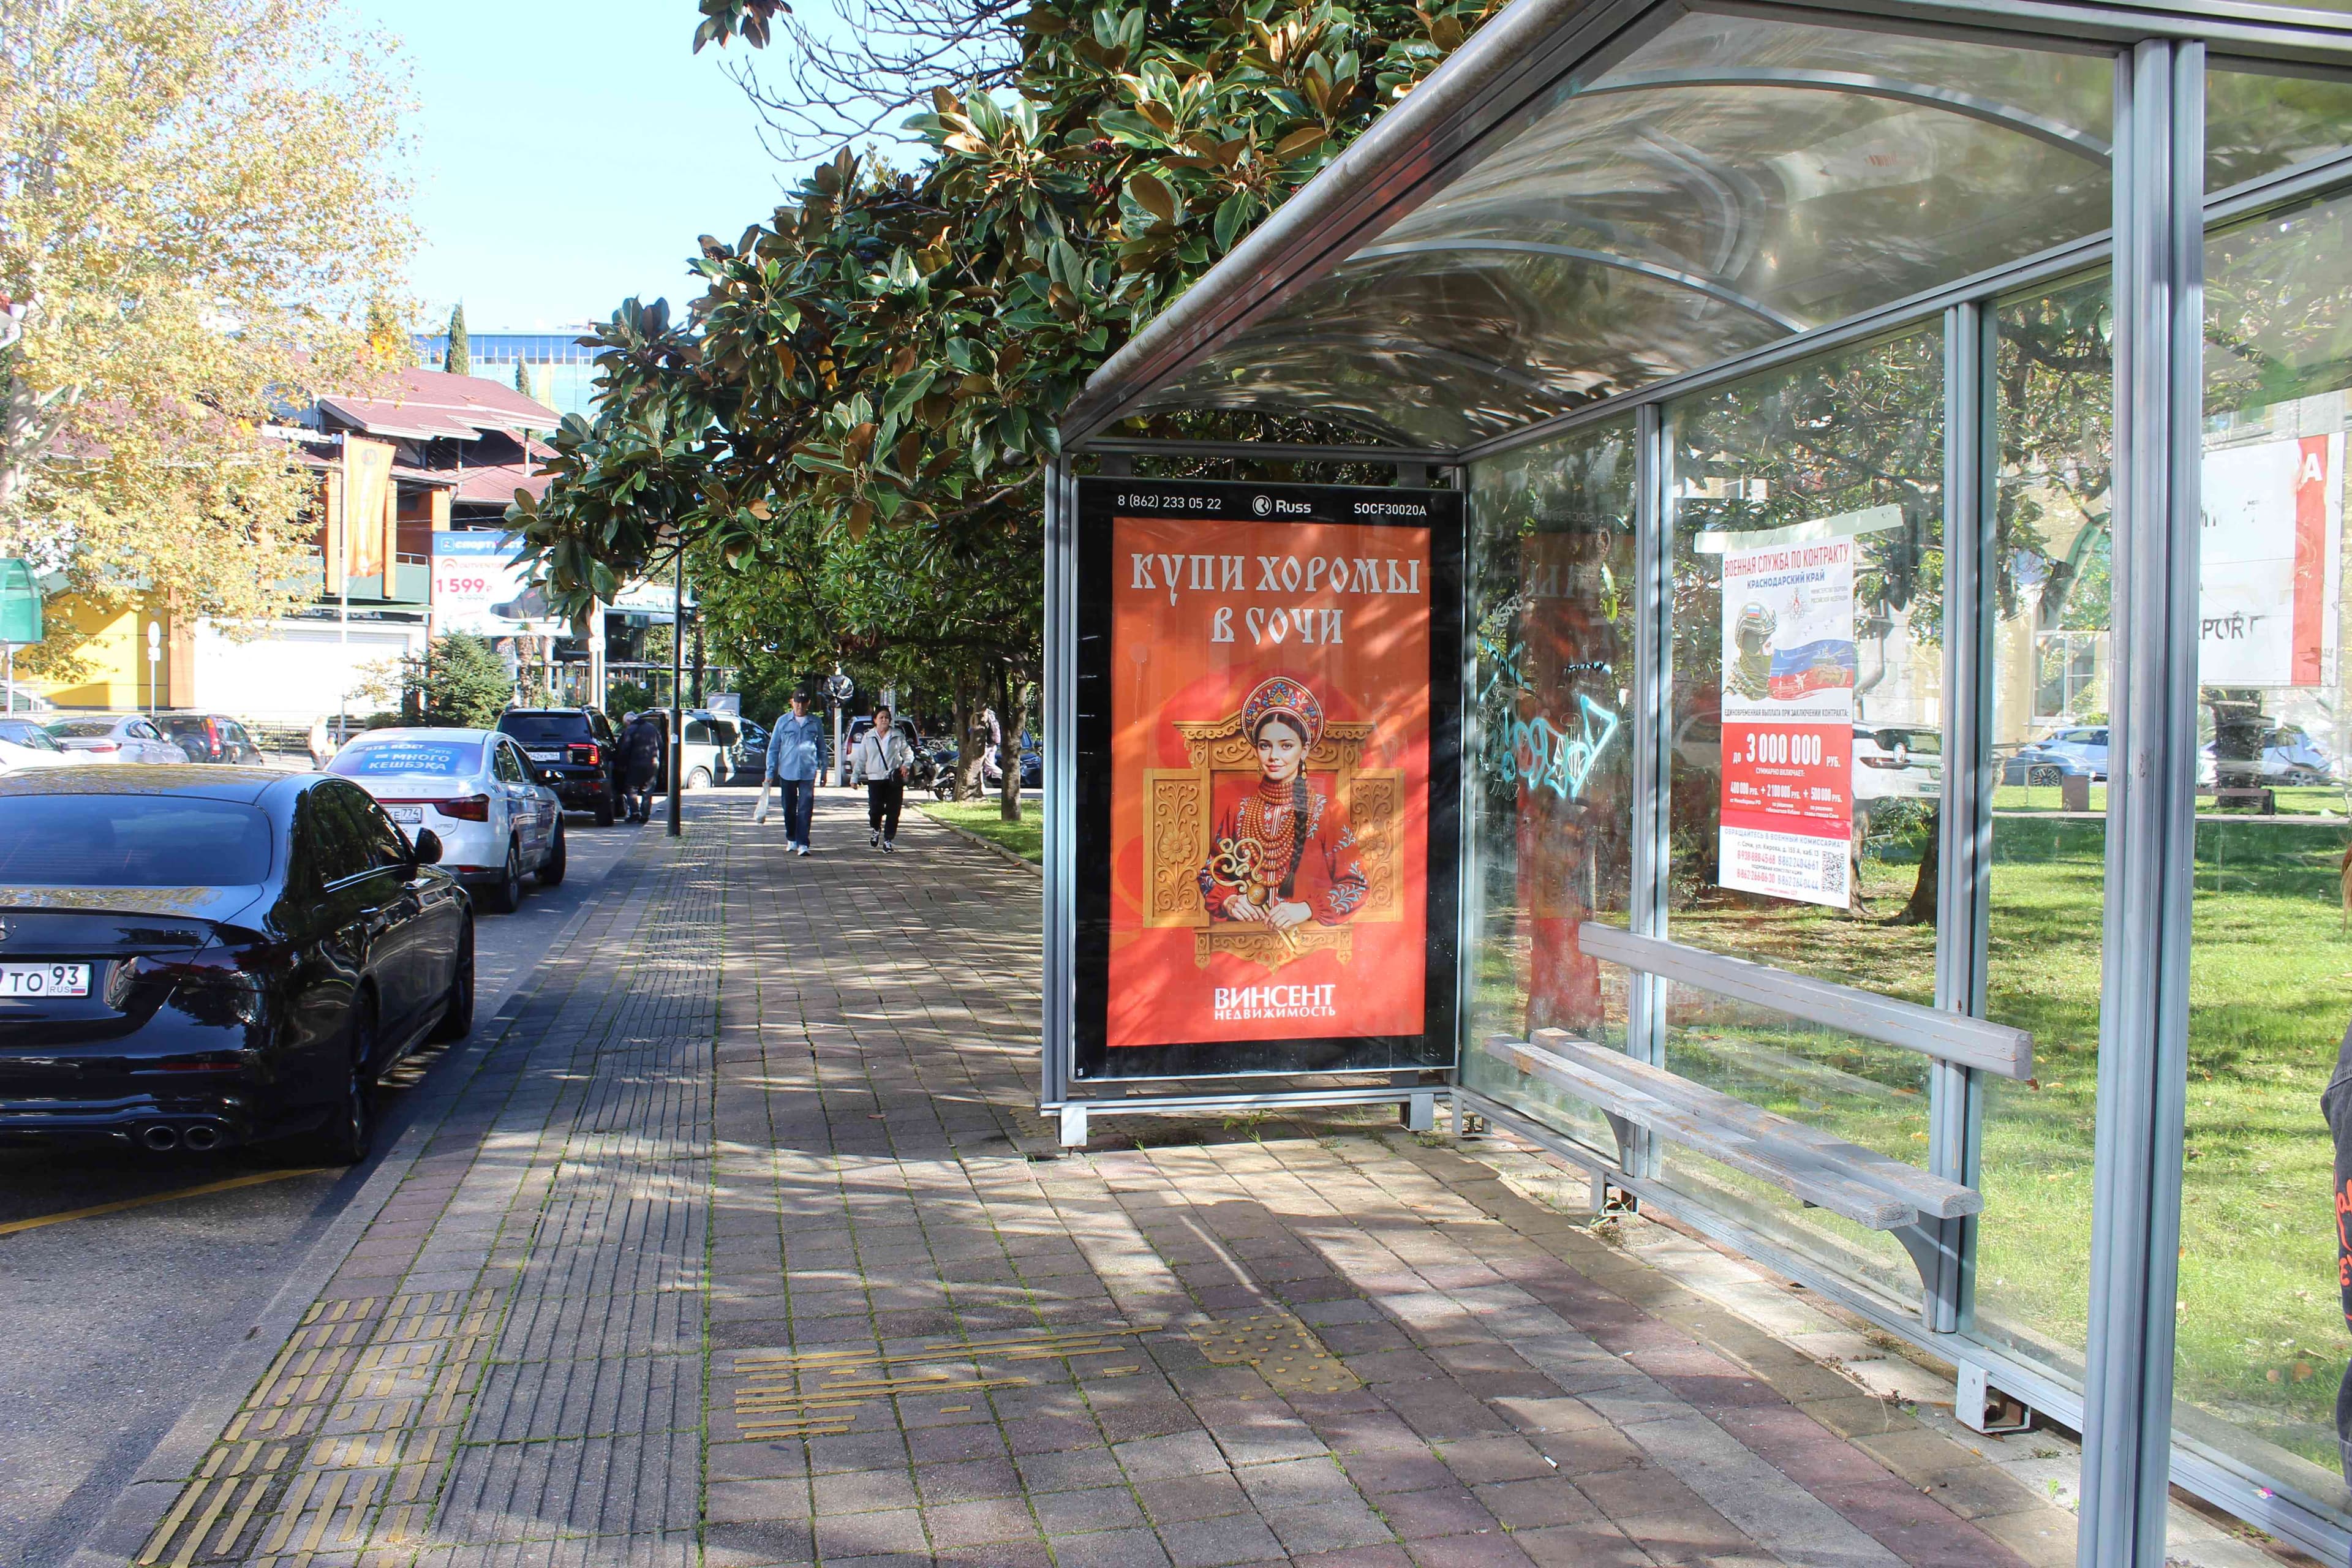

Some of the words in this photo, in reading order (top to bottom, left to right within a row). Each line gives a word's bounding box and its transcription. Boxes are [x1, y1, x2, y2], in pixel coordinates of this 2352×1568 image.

[1118, 495, 1125, 506] 8
[1129, 494, 1158, 508] (862)
[1163, 497, 1185, 508] 233
[1189, 498, 1203, 509] 05
[1207, 498, 1221, 510] 22
[1276, 500, 1311, 513] Russ
[1354, 503, 1427, 516] SOCF30020A
[1725, 556, 1756, 578] ВОЕННАЯ
[1758, 551, 1789, 573] СЛУЖБА
[1791, 550, 1801, 569] ПО
[1803, 543, 1849, 567] КОНТРАКТУ
[436, 579, 442, 593] 1
[450, 578, 484, 593] 599
[1131, 553, 1245, 606] КУПИ
[1256, 555, 1420, 594] ХОРОМЫ
[1747, 571, 1805, 589] КРАСНОДАРСКИЙ
[1806, 569, 1825, 582] КРАЙ
[1212, 606, 1235, 643] В
[1245, 607, 1343, 645] СОЧИ
[392, 753, 450, 762] МНОГО
[1746, 733, 1756, 763] 3
[1826, 756, 1841, 767] РУБ.
[369, 761, 447, 771] КЕШБЭКА
[1800, 837, 1844, 848] КОМИССАРИАТ
[53, 966, 79, 986] 93
[1215, 984, 1336, 1009] ВИНСЕНТ
[1215, 1006, 1336, 1020] НЕДВИЖИМОСТЬ
